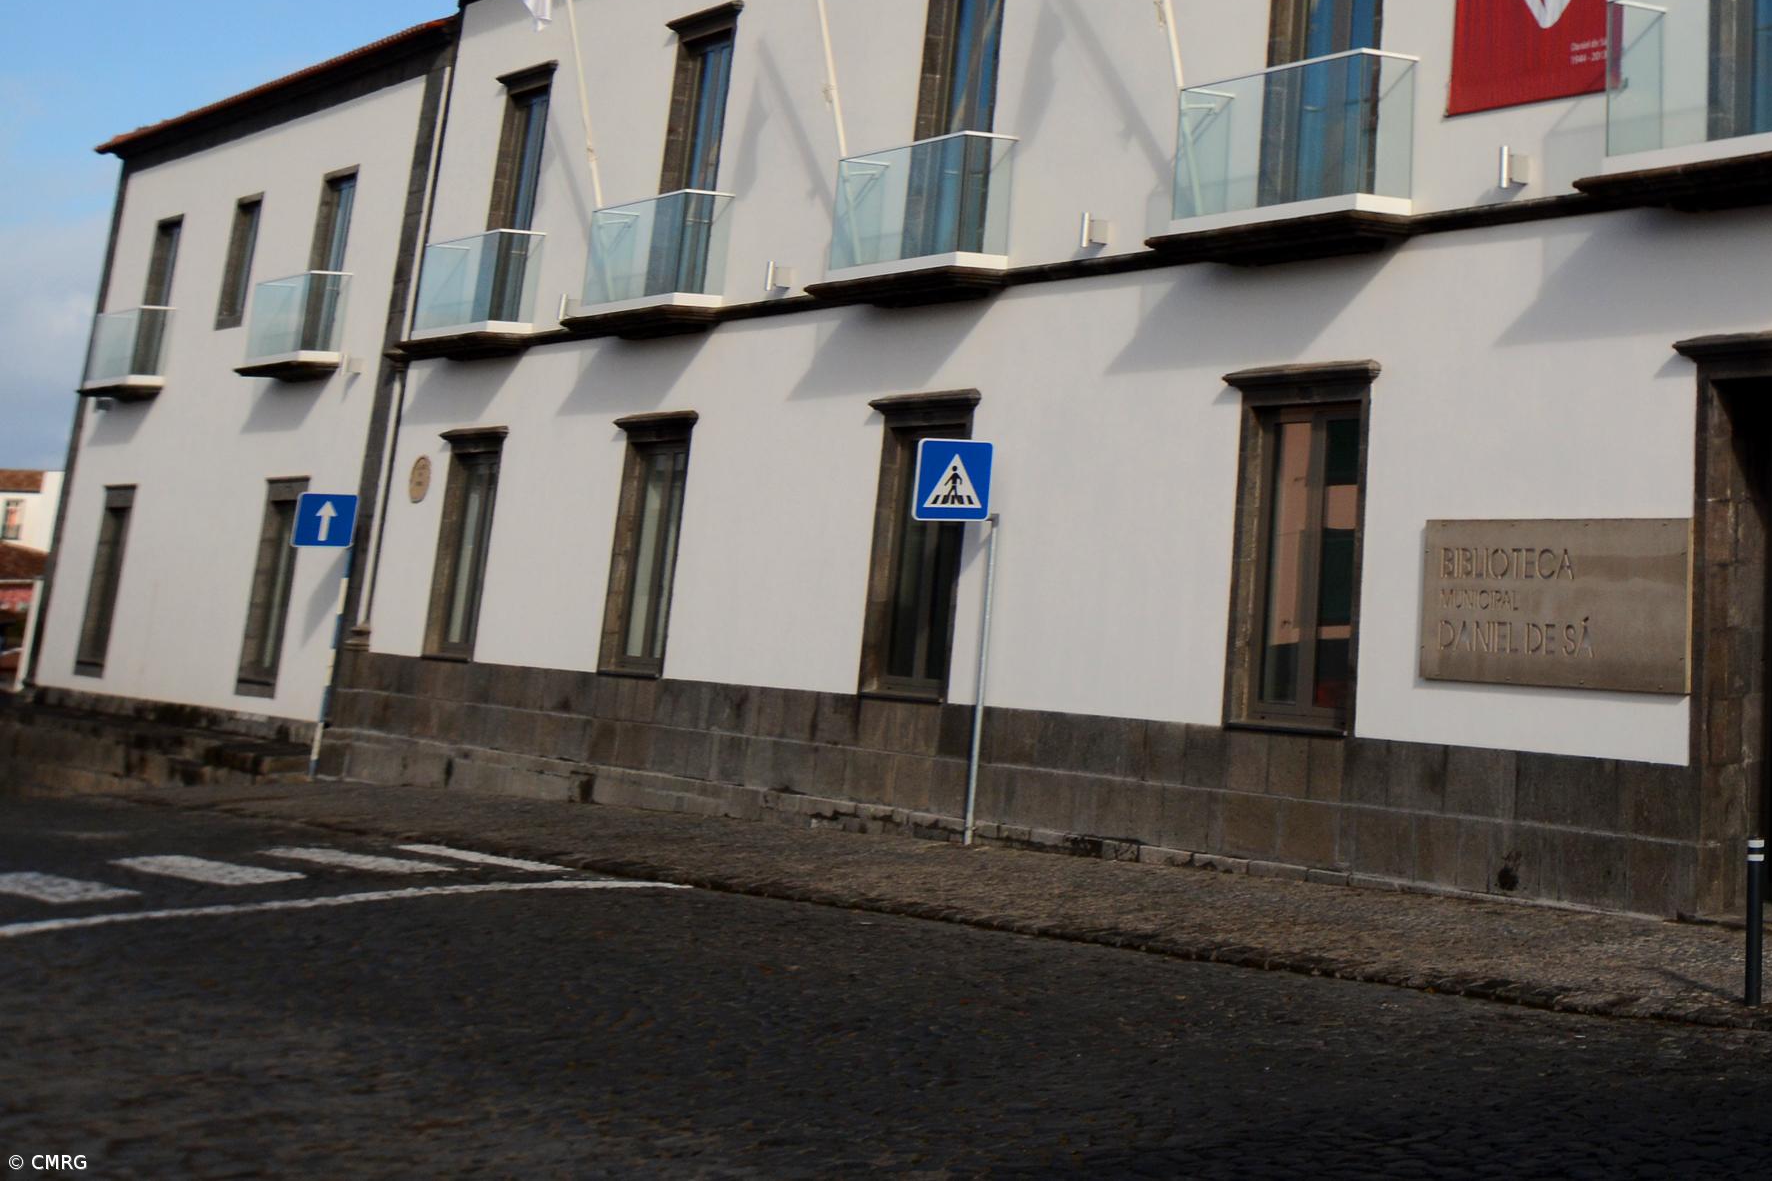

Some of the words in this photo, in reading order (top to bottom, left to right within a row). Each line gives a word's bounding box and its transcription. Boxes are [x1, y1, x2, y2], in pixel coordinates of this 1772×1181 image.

[1440, 547, 1574, 580] BIBLIOTECA
[1439, 589, 1519, 611] MUNICIPAL
[1438, 620, 1518, 654] DANIEL
[1524, 622, 1556, 655] DE
[1562, 616, 1595, 658] SÁ
